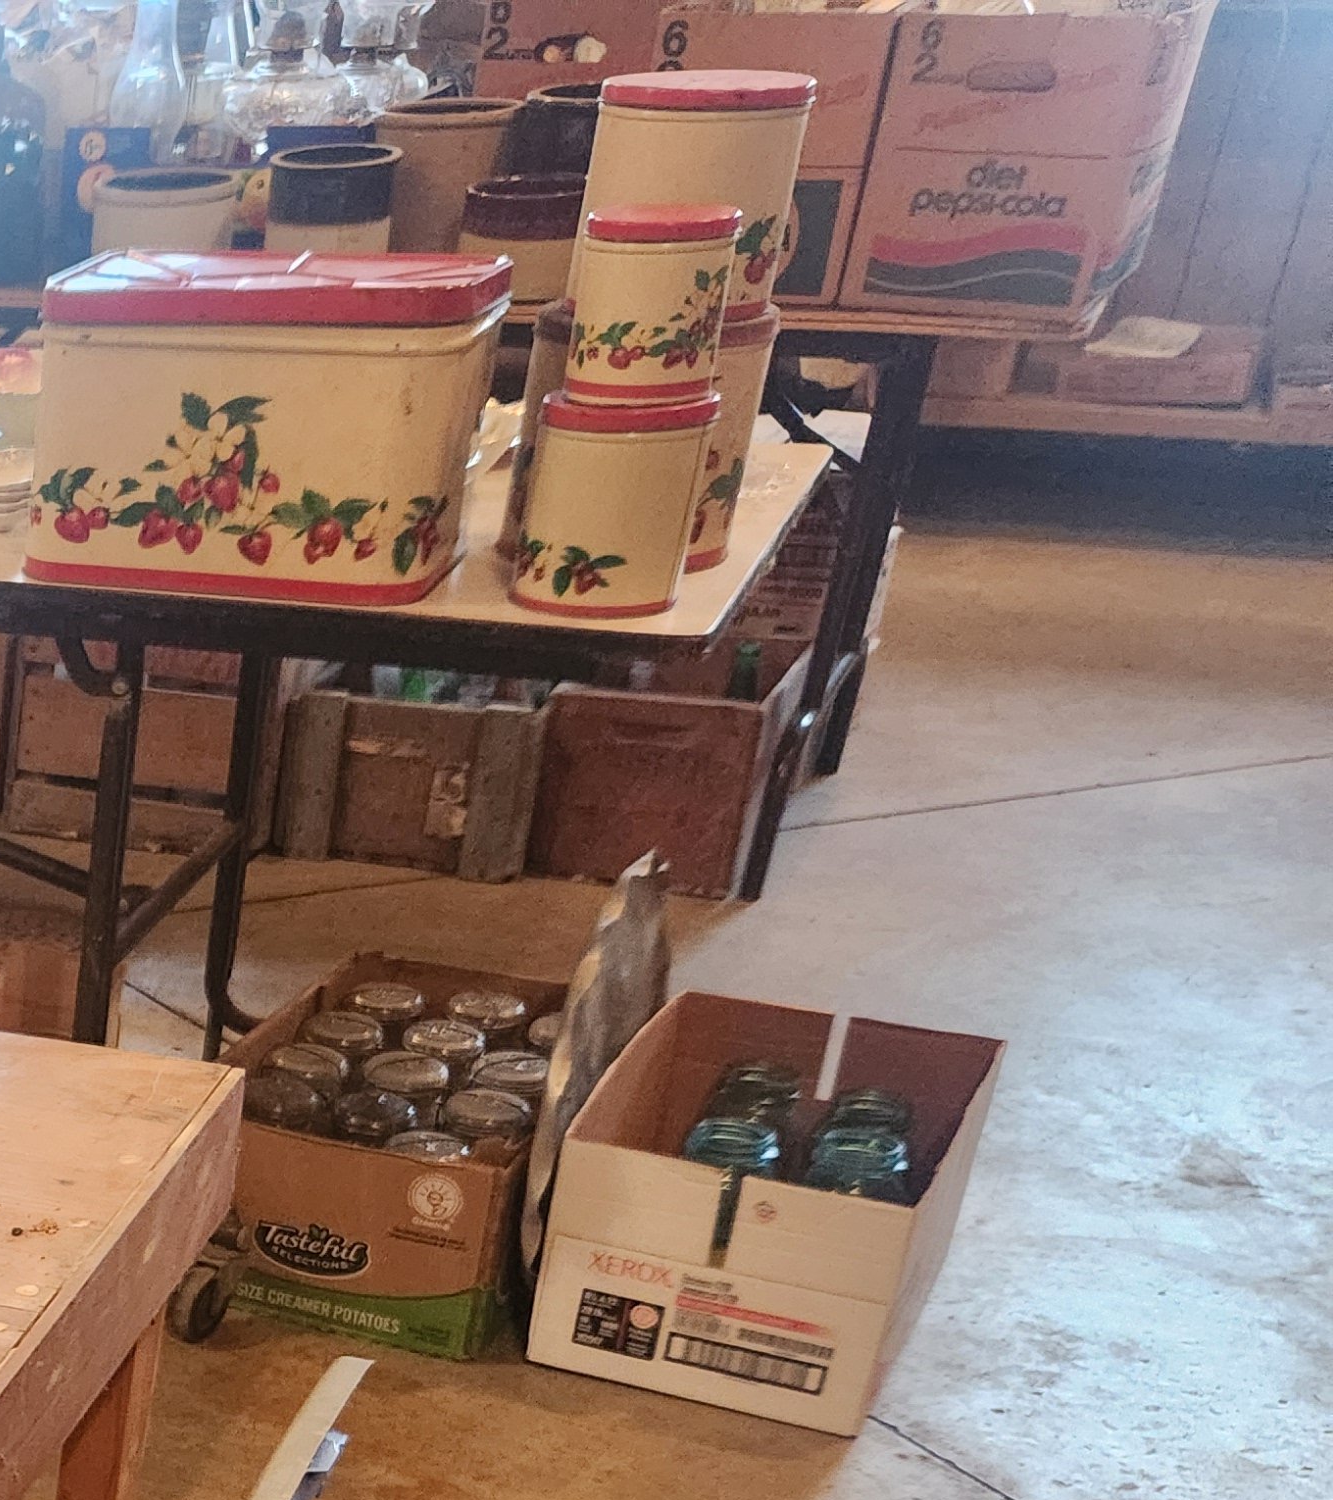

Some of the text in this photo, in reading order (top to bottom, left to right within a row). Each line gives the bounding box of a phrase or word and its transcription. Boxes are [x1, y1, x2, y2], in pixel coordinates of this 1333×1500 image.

[662, 19, 689, 58] 6
[966, 157, 1027, 190] diet
[259, 1221, 367, 1262] Tasteful
[271, 1245, 350, 1270] SELECTIONS
[586, 1250, 675, 1290] XEROX
[236, 1283, 401, 1335] SIZE CREAMER POTATOES
